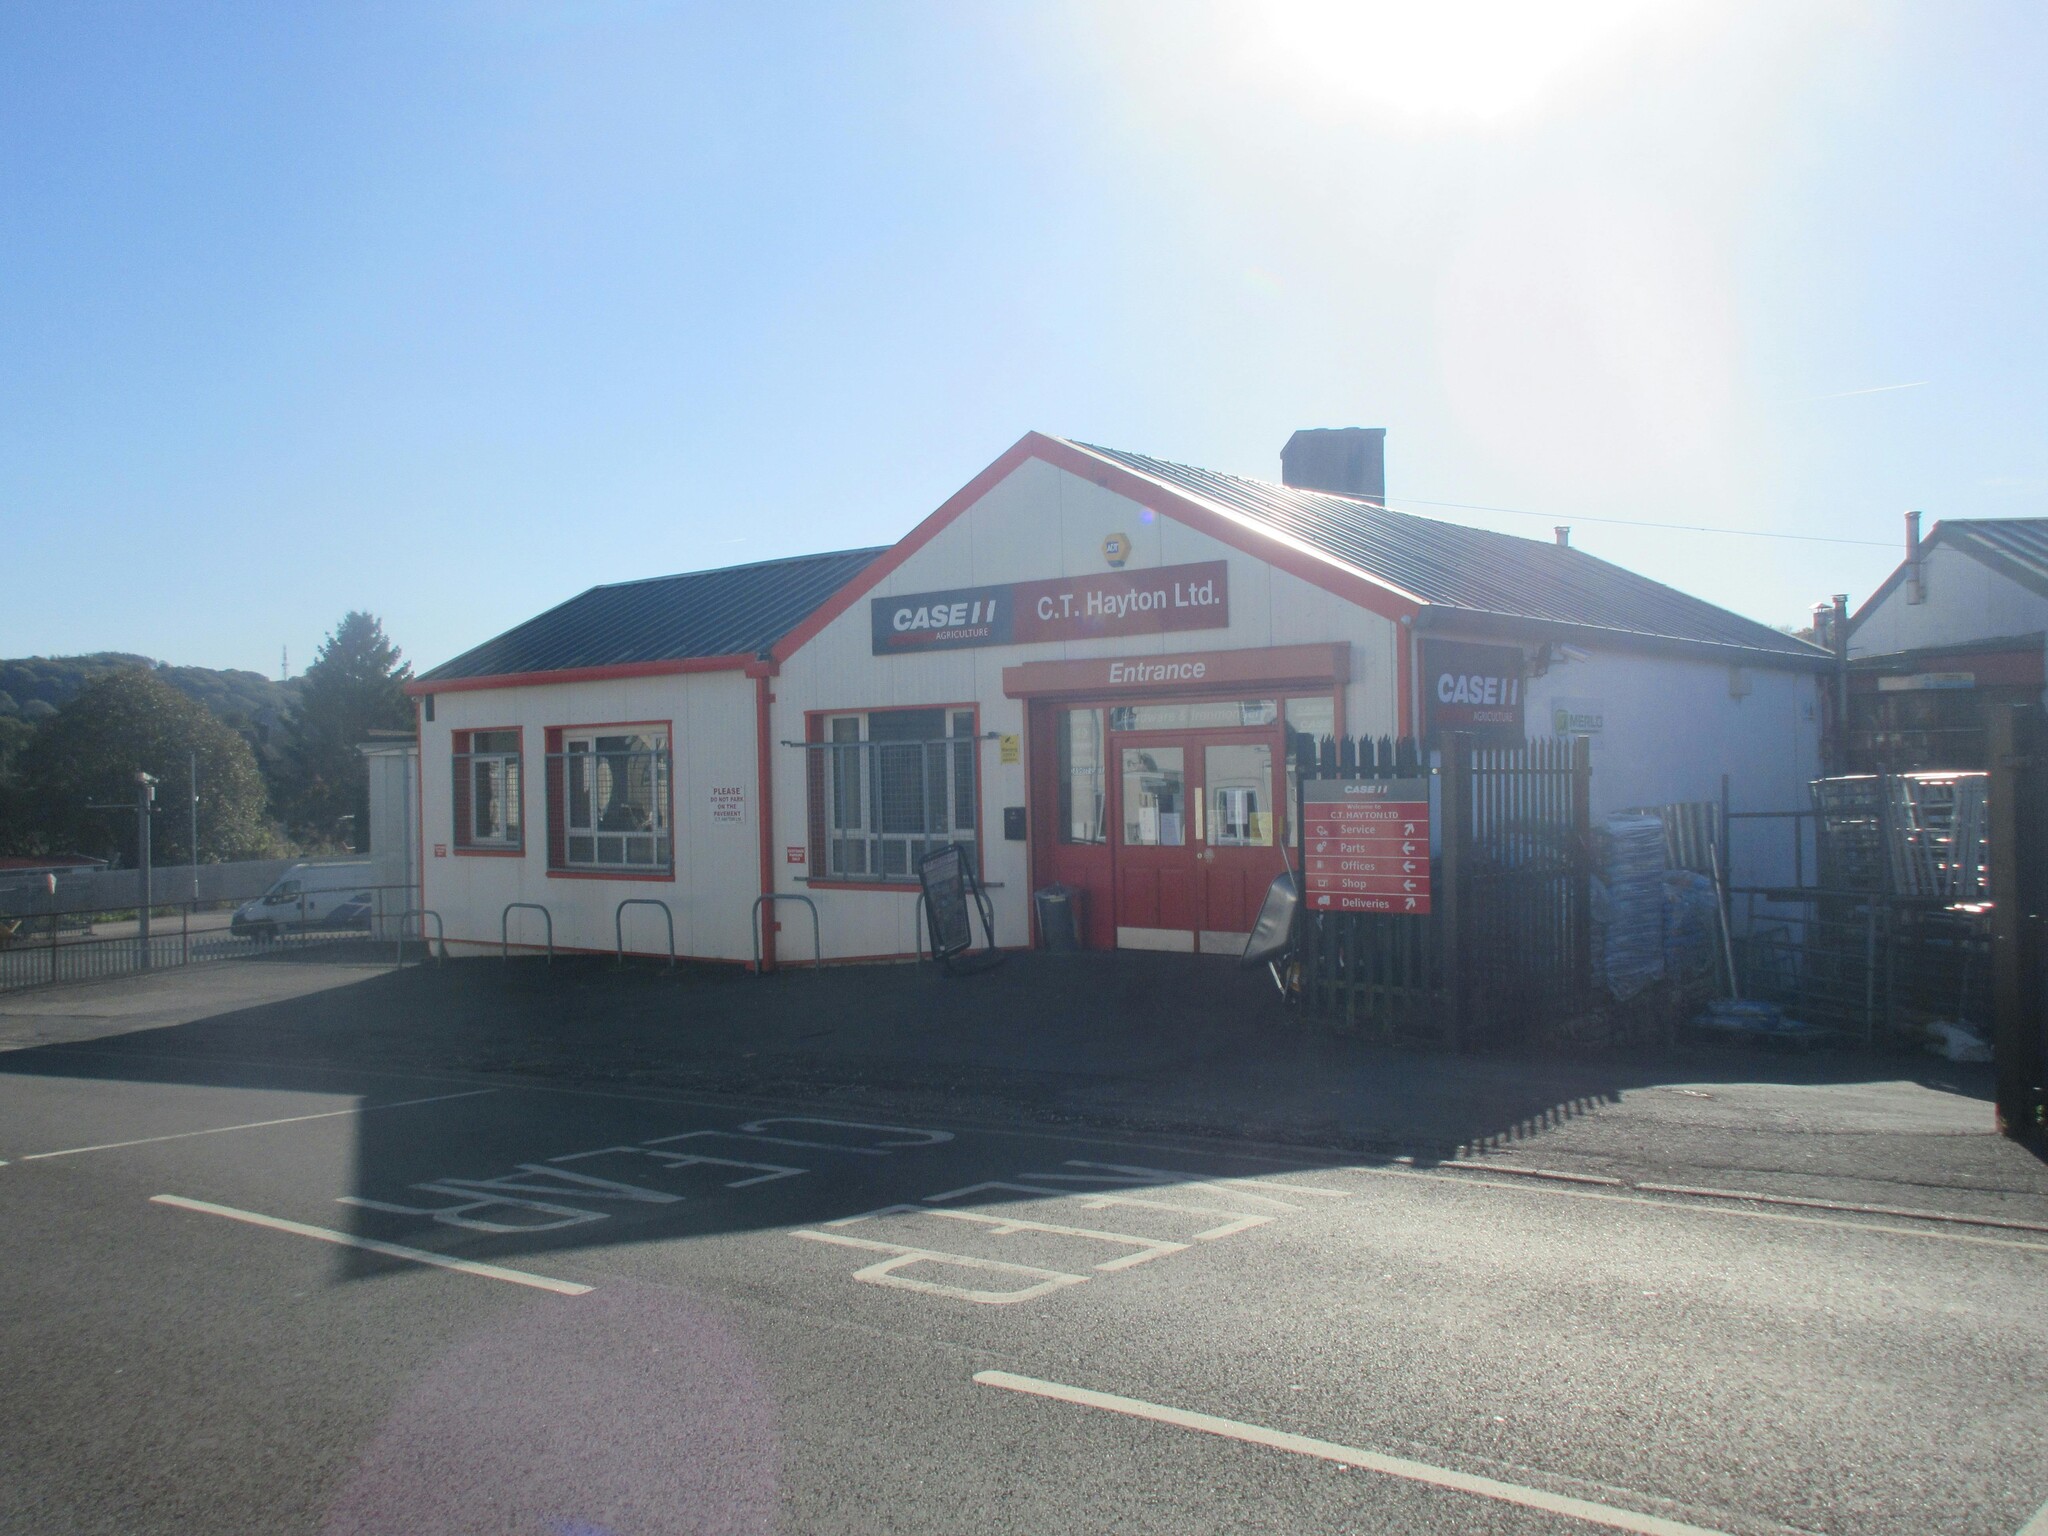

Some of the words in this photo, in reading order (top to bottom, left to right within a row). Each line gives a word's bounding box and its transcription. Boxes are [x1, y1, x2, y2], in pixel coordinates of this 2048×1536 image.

[1037, 594, 1082, 621] C.T.
[1087, 584, 1167, 617] Hayton
[1174, 580, 1220, 607] Ltd.
[893, 602, 968, 631] CASE
[936, 628, 989, 640] AGRICULTURE
[1109, 661, 1206, 684] Entrance
[1437, 673, 1497, 705] CASE
[1473, 711, 1513, 722] AGRICULTURE
[713, 787, 741, 795] PLEASE
[1344, 785, 1375, 794] CASE
[1346, 811, 1383, 819] HAYTON
[1384, 811, 1399, 819] LTD
[1341, 824, 1376, 834] Service
[1340, 843, 1366, 853] Parts
[1341, 861, 1375, 871] Offices
[1342, 878, 1367, 890] Shop
[1342, 898, 1390, 909] Deliveries
[334, 1117, 956, 1233] CLEAR
[787, 1160, 1351, 1304] KEEP
